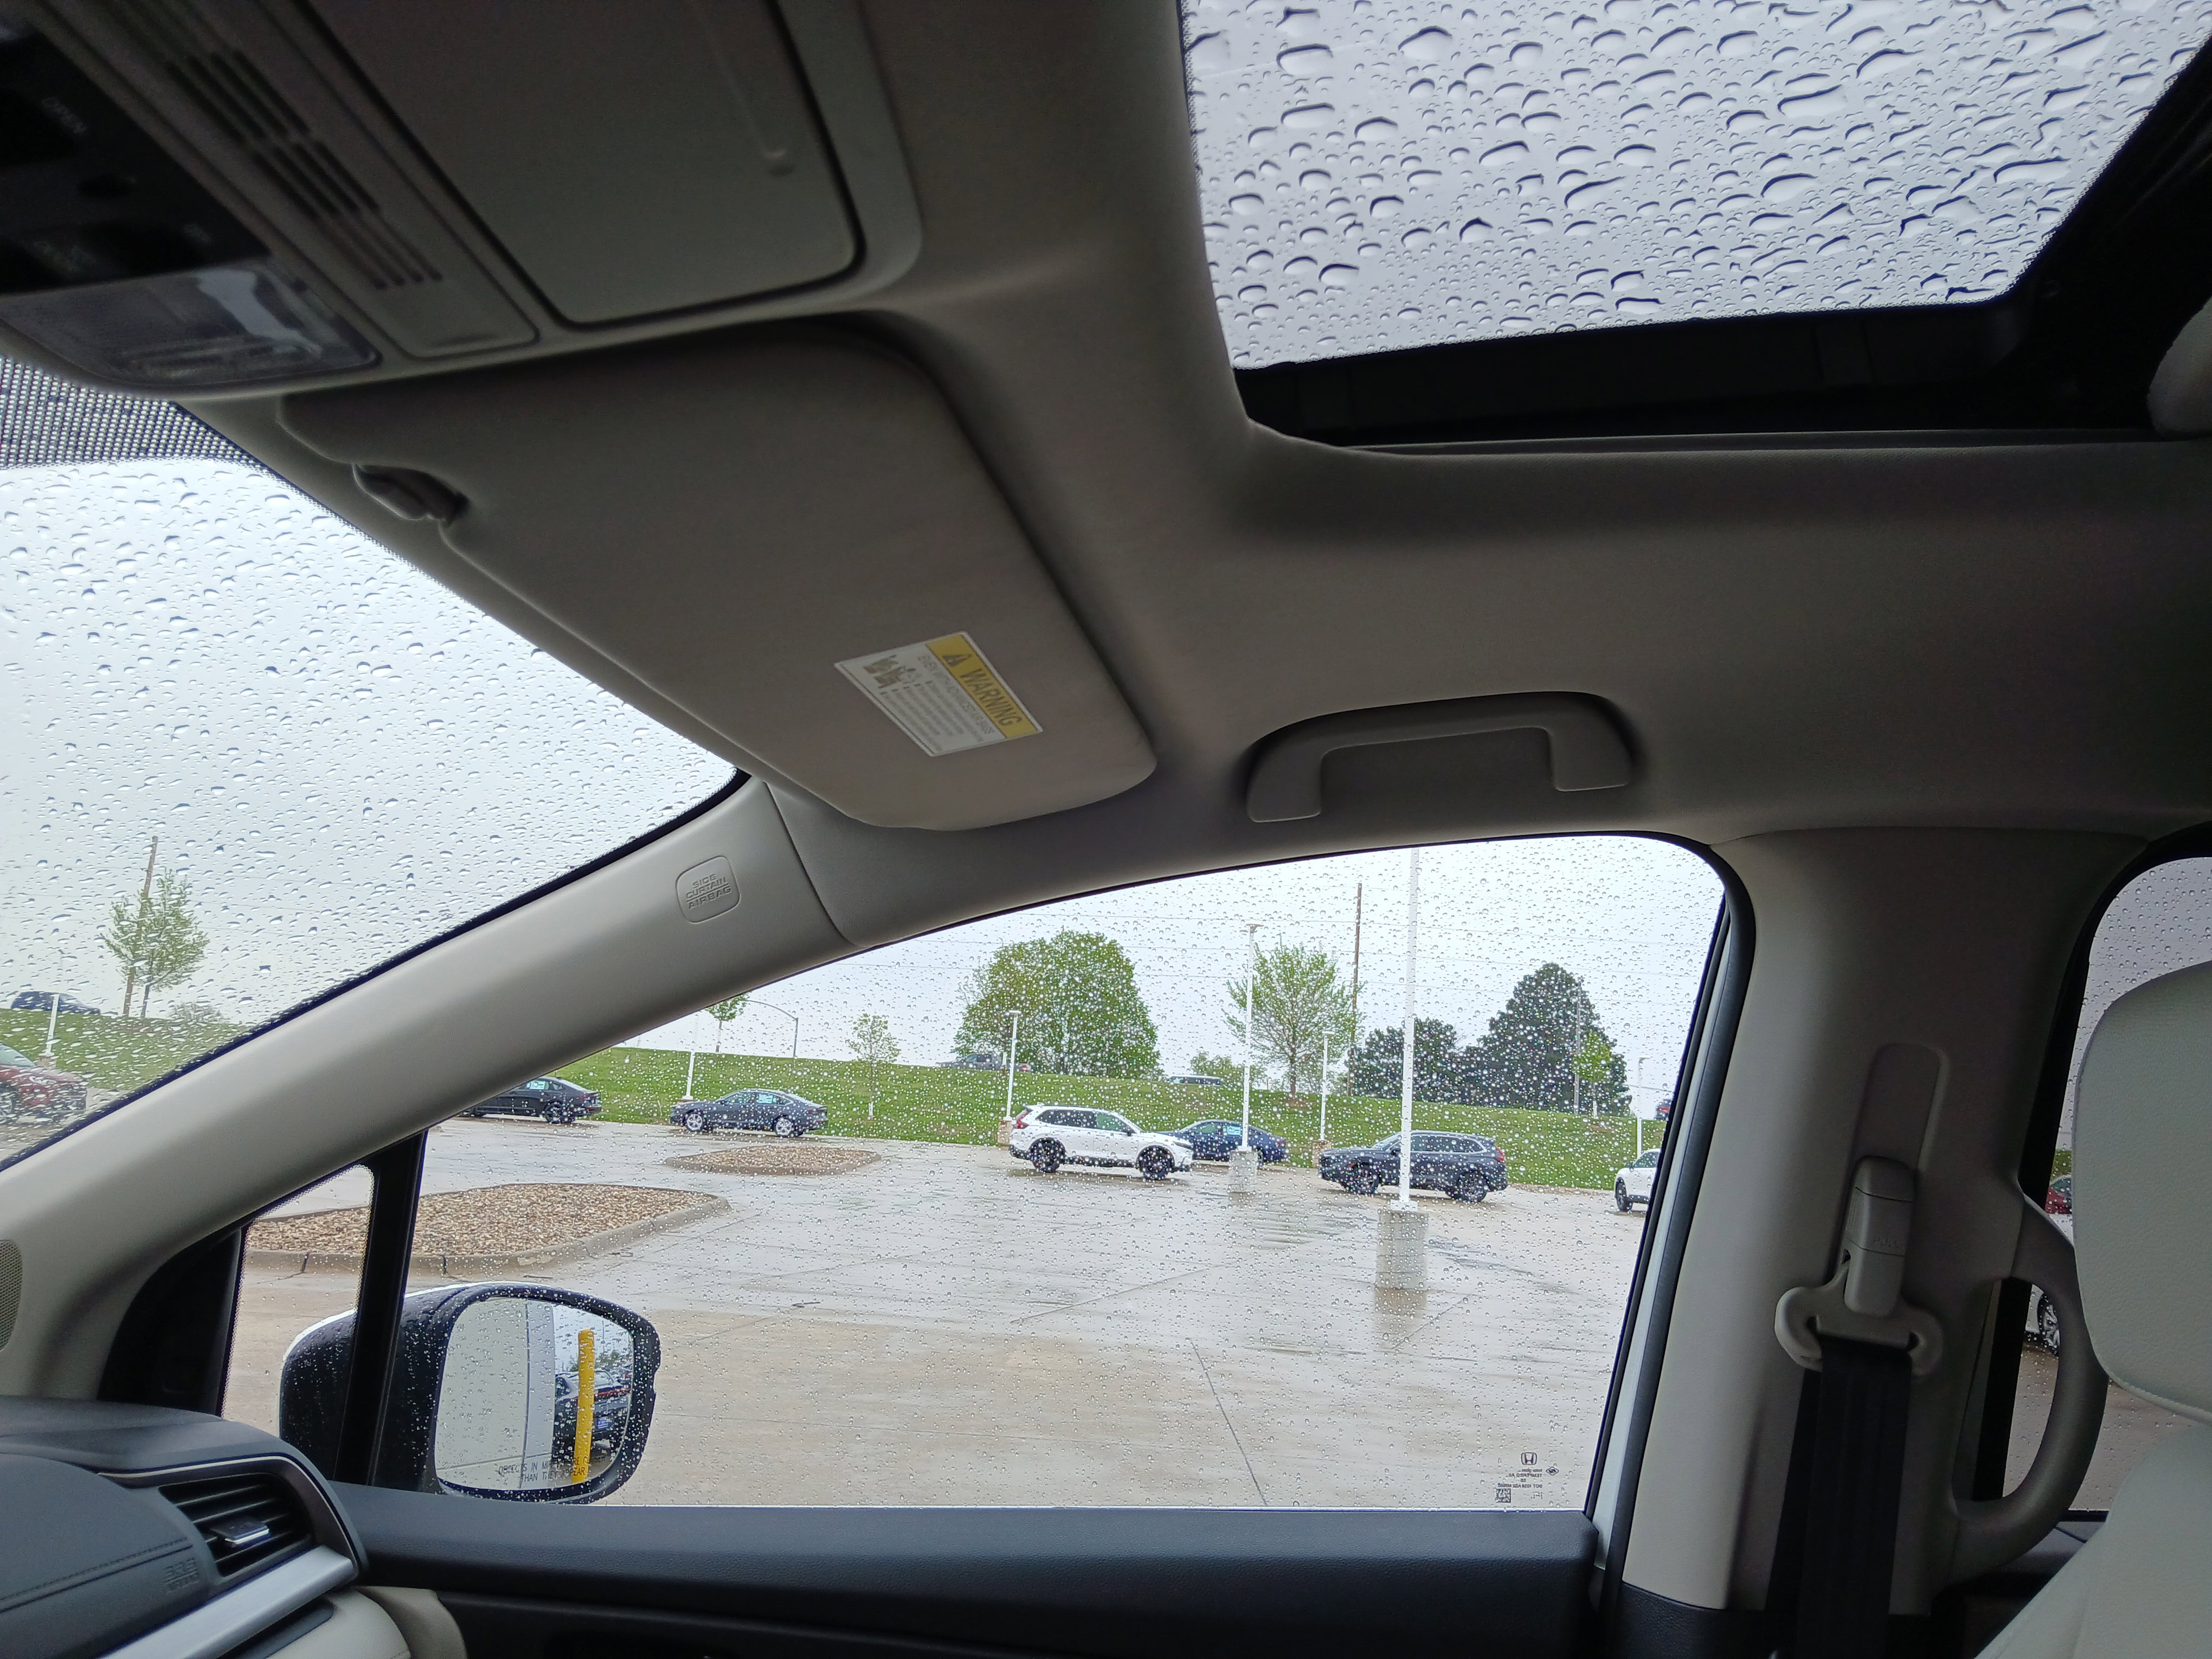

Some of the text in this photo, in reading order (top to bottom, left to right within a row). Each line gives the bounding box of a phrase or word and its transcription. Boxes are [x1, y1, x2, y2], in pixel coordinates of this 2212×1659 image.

[960, 668, 1023, 726] WARNING
[688, 885, 731, 909] AIRBAG
[531, 1461, 538, 1472] IN
